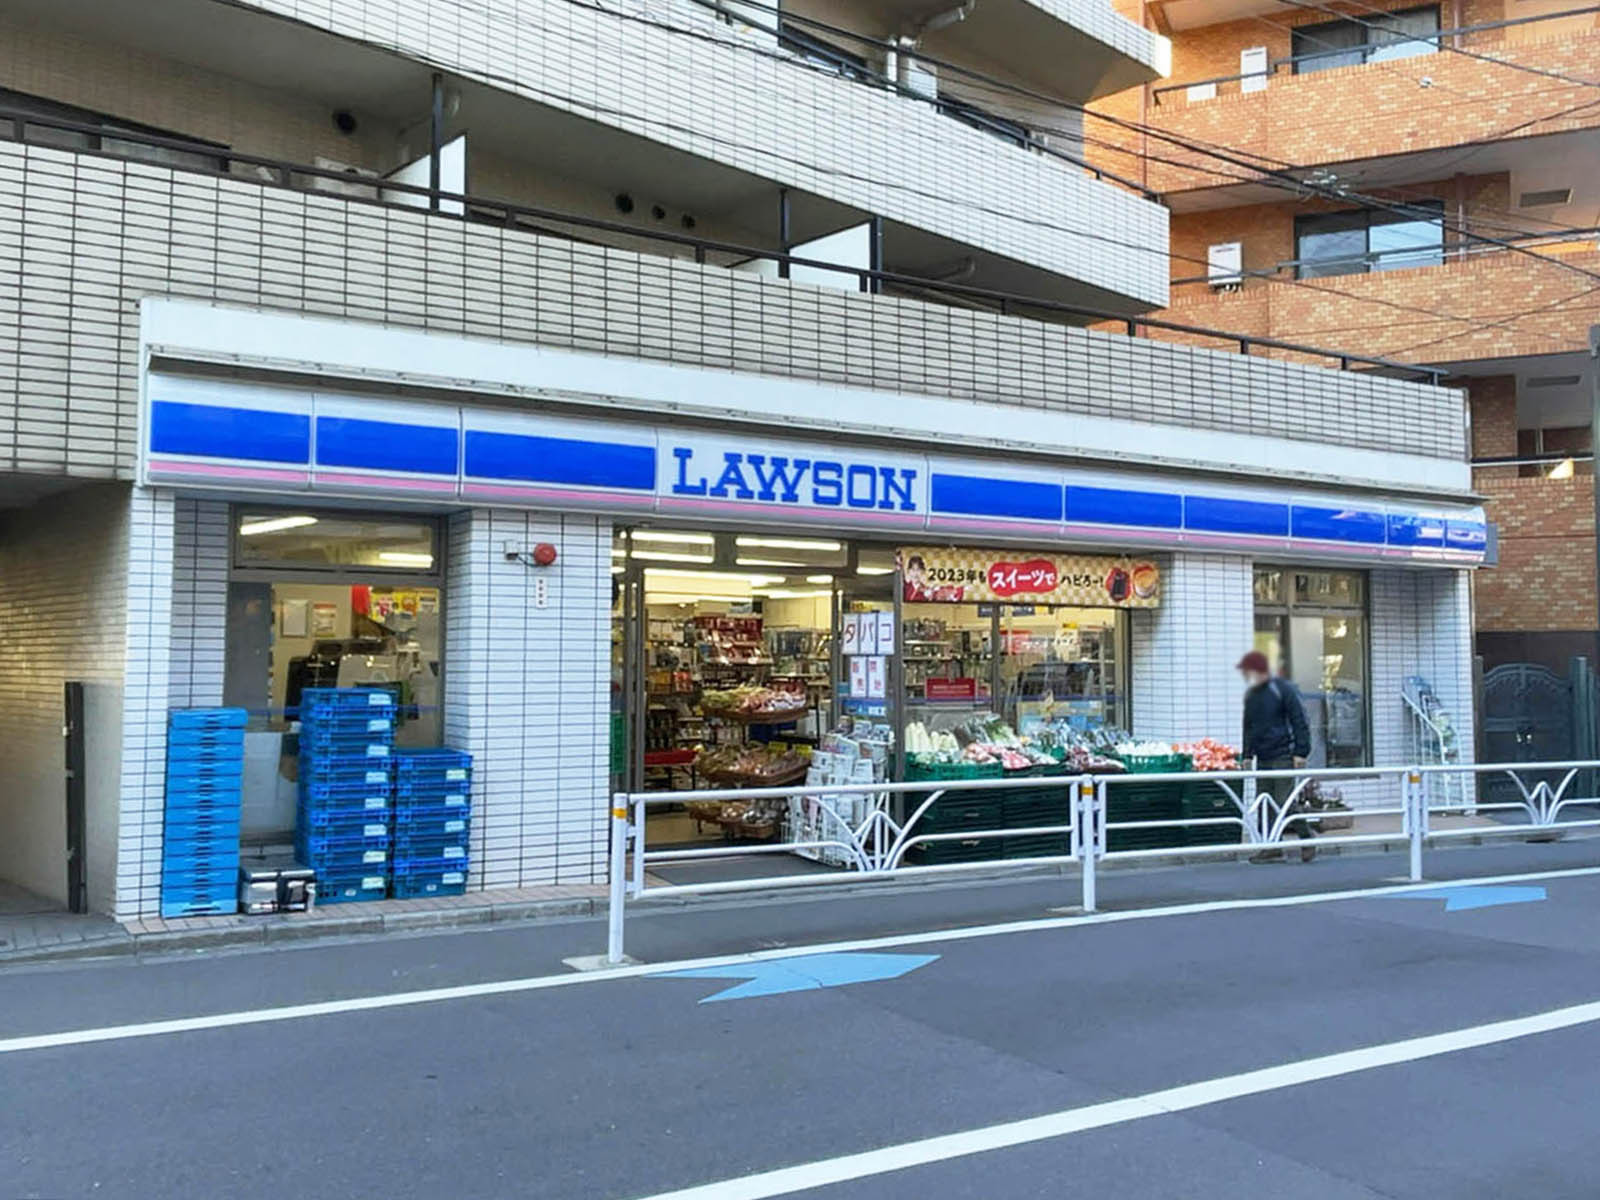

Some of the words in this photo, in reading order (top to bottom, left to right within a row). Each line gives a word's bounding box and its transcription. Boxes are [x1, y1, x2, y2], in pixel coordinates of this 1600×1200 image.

[673, 448, 917, 511] LAWSON
[928, 567, 986, 584] 2023年も
[991, 568, 1056, 589] スイーツで
[845, 622, 892, 644] タバコ
